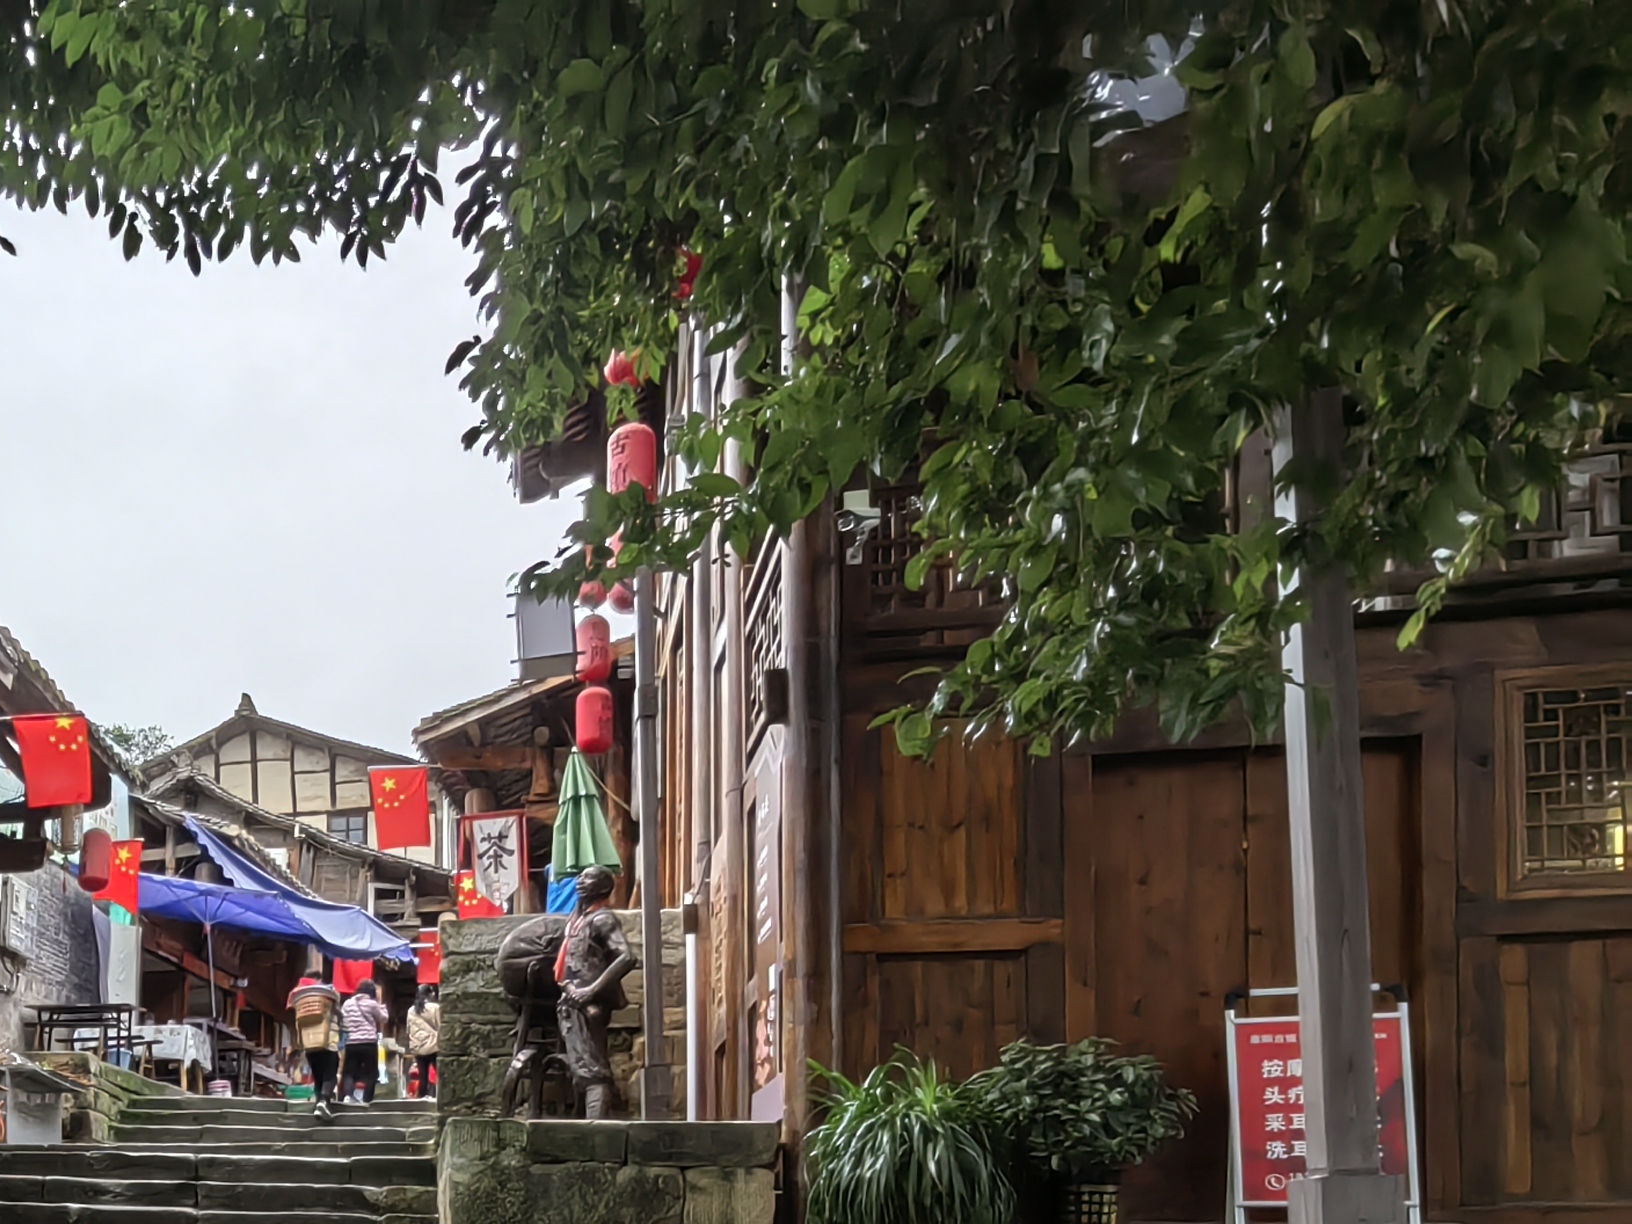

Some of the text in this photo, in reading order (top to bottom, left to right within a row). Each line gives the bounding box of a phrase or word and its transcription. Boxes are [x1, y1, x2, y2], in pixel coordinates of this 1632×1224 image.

[477, 831, 515, 875] 茶
[1263, 1086, 1304, 1105] 头疗
[1264, 1113, 1306, 1132] 采耳
[1266, 1140, 1307, 1159] 洗耳
